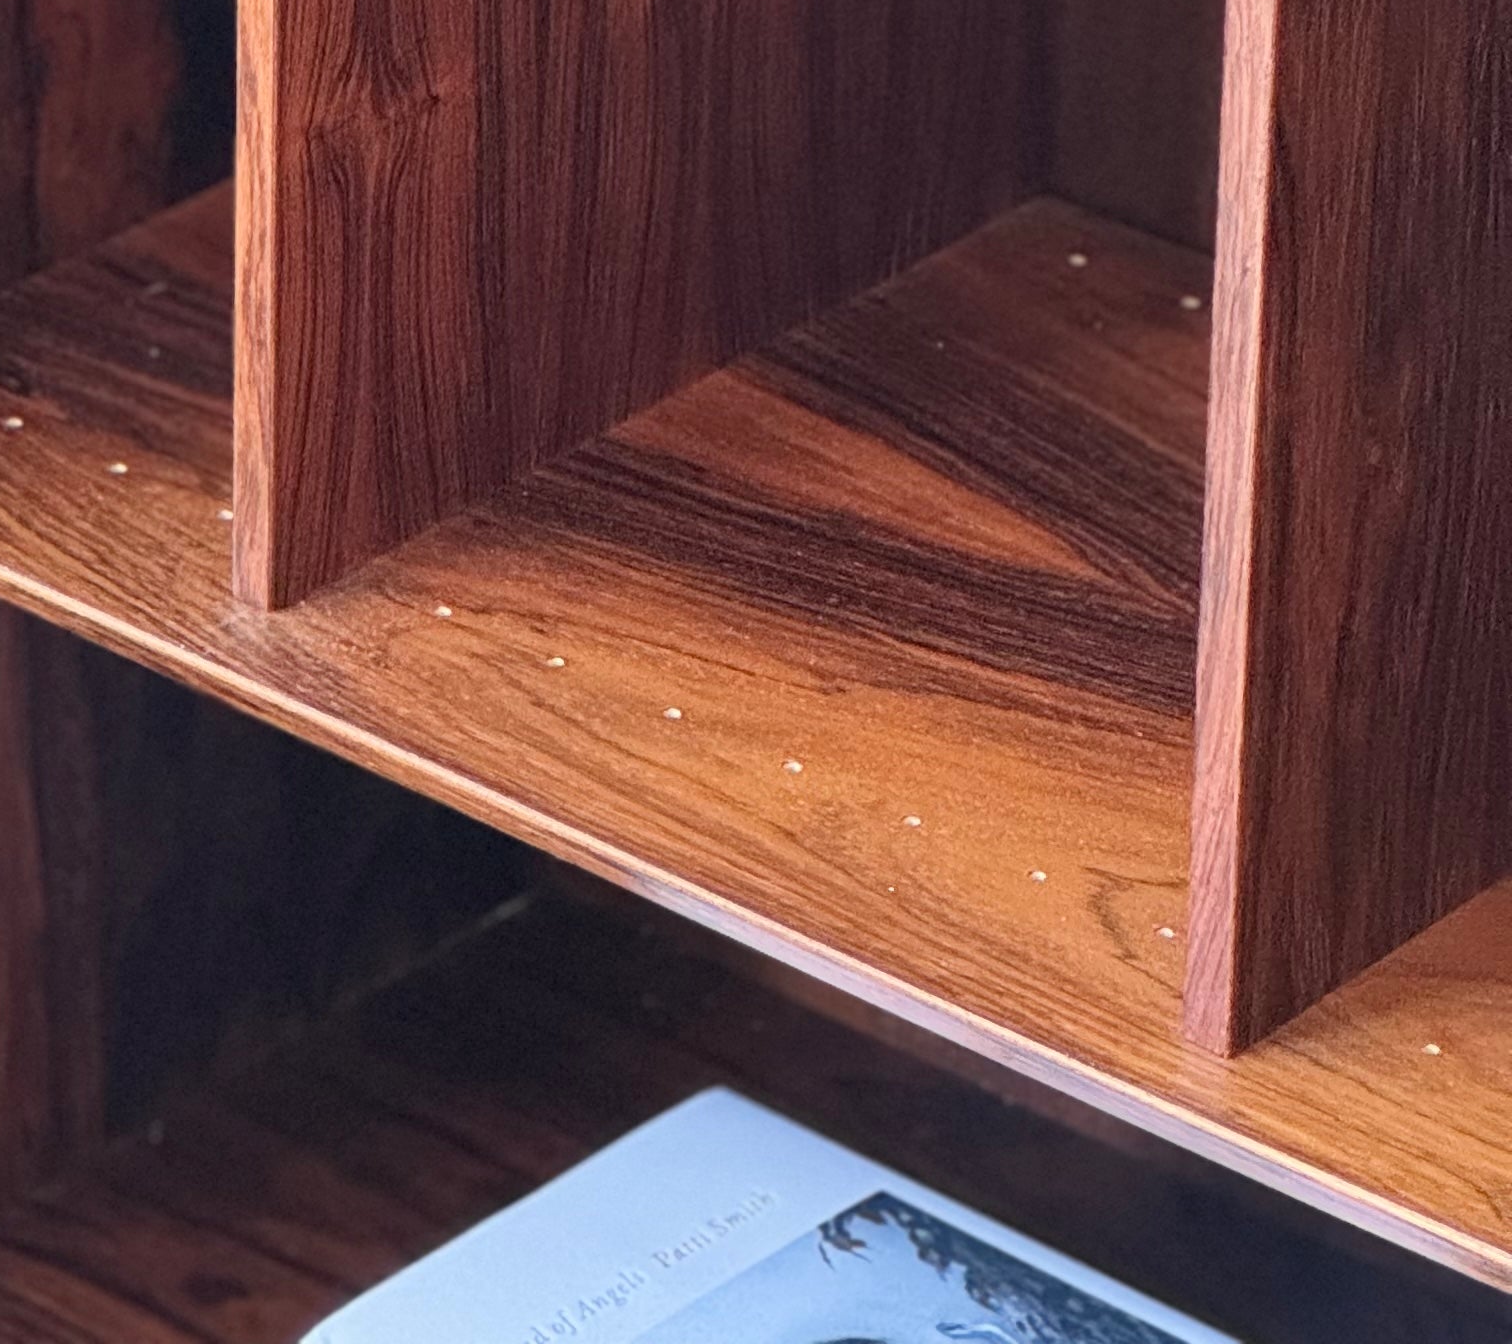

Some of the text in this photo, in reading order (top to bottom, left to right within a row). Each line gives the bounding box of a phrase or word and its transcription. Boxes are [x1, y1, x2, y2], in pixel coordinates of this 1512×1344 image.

[551, 1309, 578, 1336] of
[578, 1271, 646, 1322] Angels
[651, 1232, 712, 1269] Patti
[706, 1191, 775, 1238] Smith
